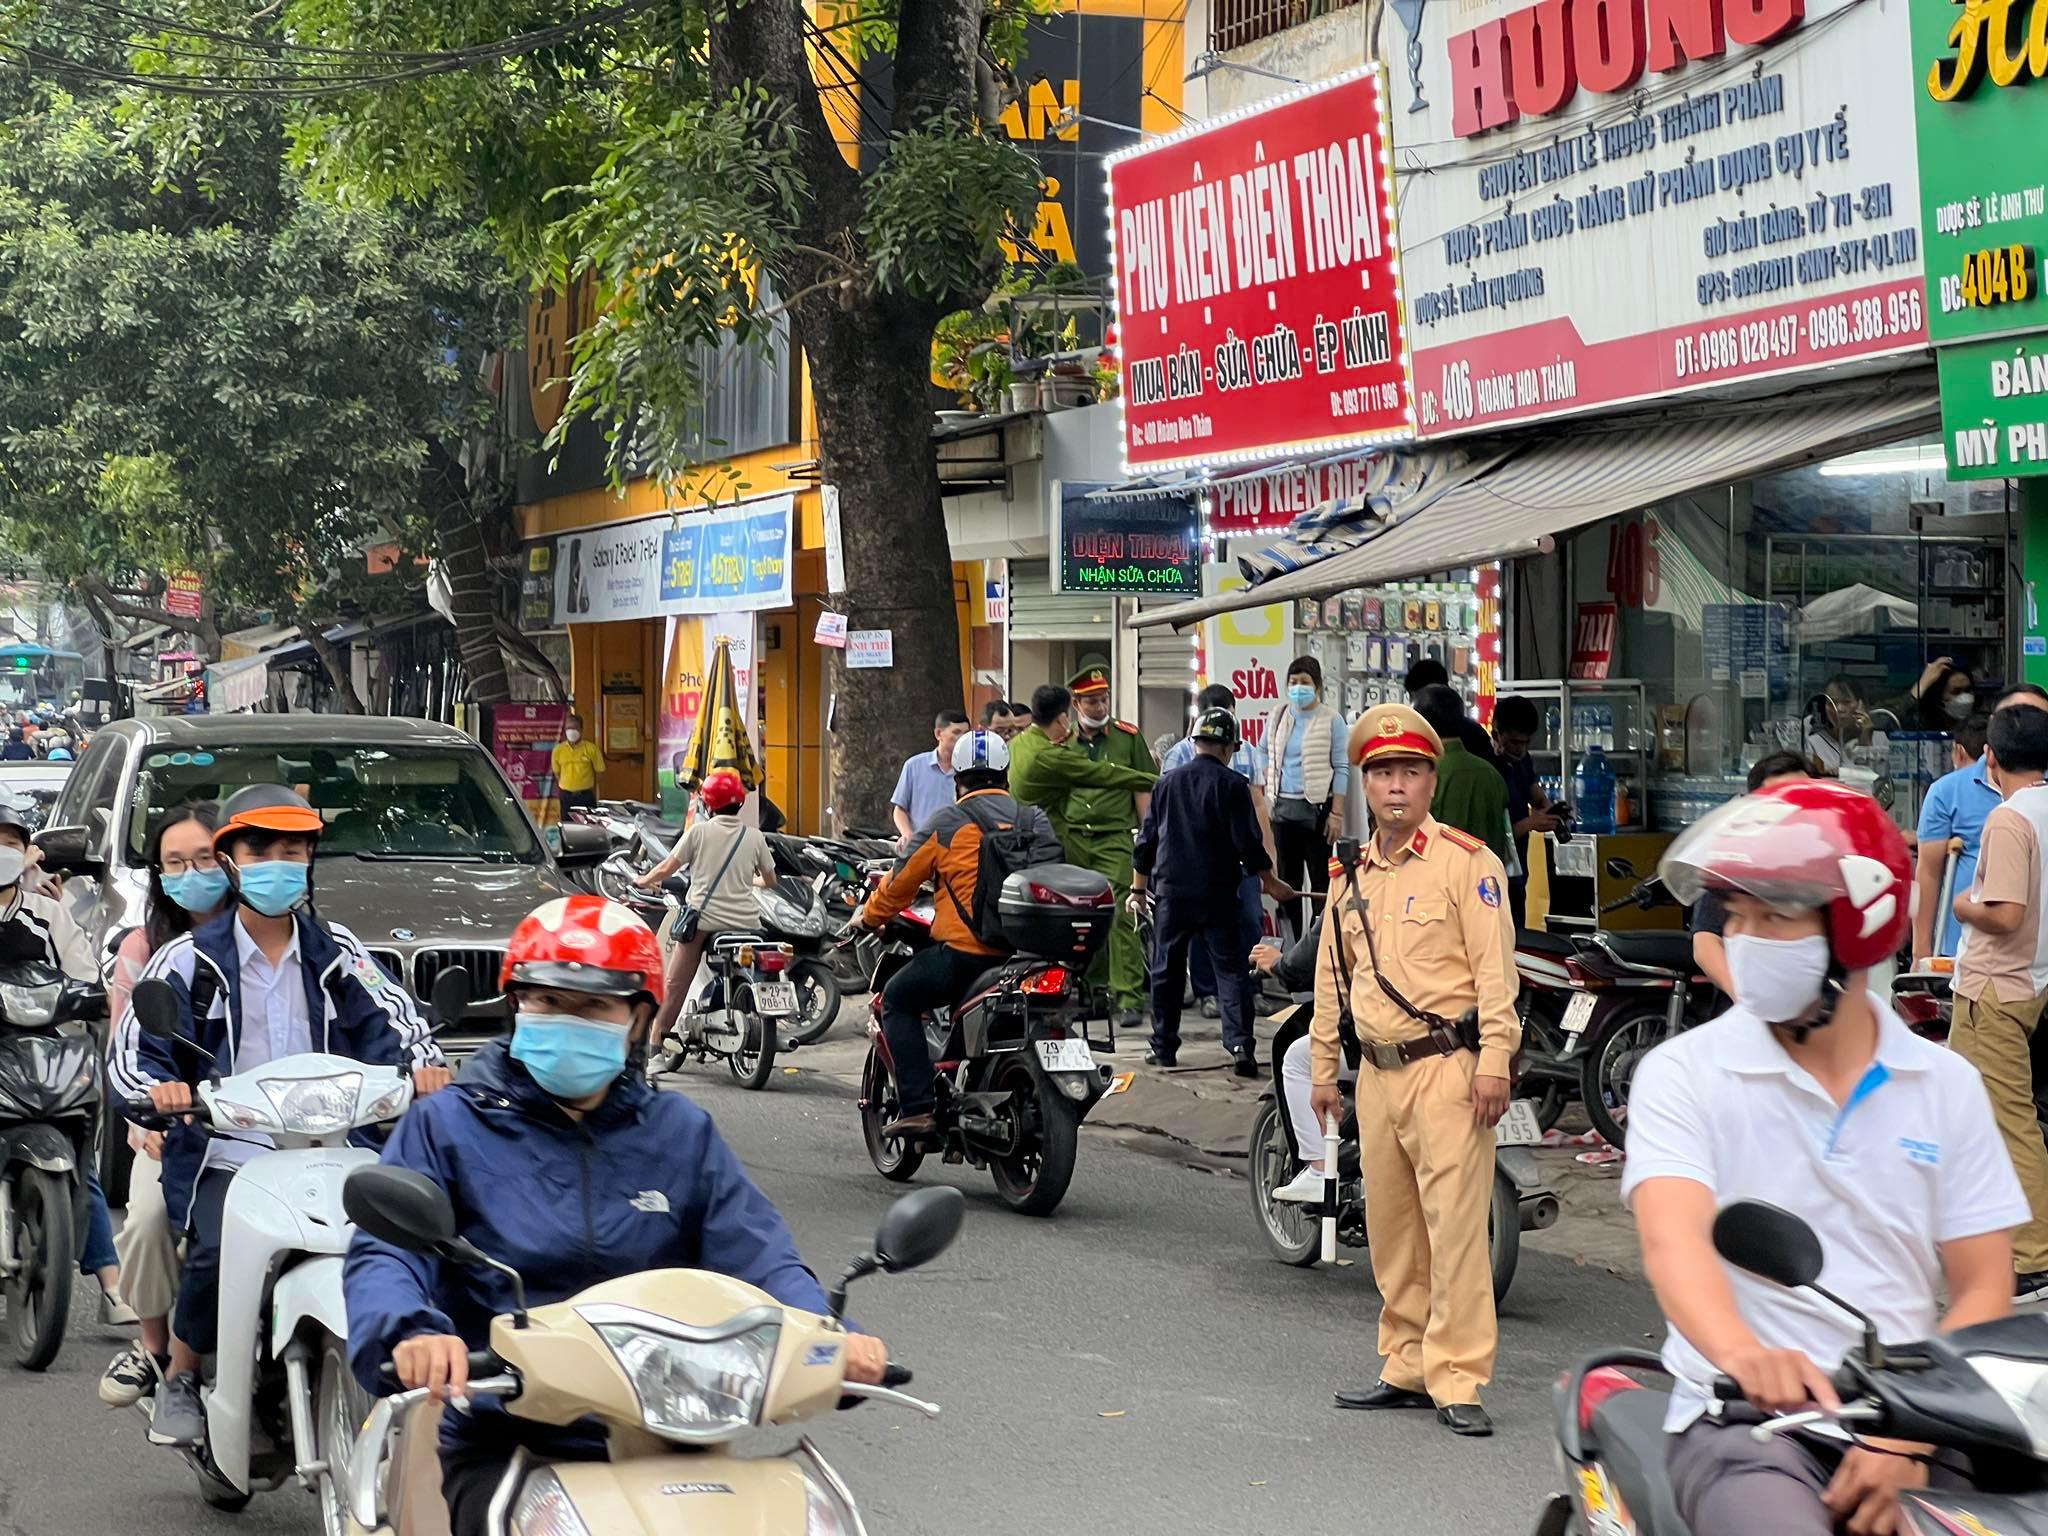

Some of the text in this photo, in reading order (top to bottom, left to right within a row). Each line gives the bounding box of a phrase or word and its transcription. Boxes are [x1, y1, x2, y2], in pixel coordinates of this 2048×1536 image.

[1539, 135, 1575, 183] BÁN
[1723, 60, 1784, 124] PHẨM
[1658, 146, 1715, 207] PHẨM
[1718, 142, 1772, 196] DỤNG
[1775, 132, 1804, 179] CỤ
[1805, 128, 1820, 166] Y
[1821, 104, 1849, 160] TẾ
[1121, 133, 1381, 333] PHỤ KIỆN ĐIỆN THOẠI
[1986, 191, 1998, 224] LÊ
[2001, 192, 2022, 221] ANH
[1809, 288, 1922, 350] 0986.388.956
[1131, 357, 1166, 406] MUA
[1167, 343, 1202, 400] BÁN
[1215, 329, 1252, 392] SỬA
[1252, 323, 1302, 383] CHỮA
[1314, 315, 1338, 374] ÉP
[1341, 307, 1391, 369] KÍNH
[1442, 360, 1473, 420] 406
[1477, 370, 1516, 415] HOÀNG
[1516, 368, 1540, 407] HOA
[1541, 354, 1577, 401] THÁM
[1357, 386, 1369, 413] 77
[1369, 384, 1381, 411] 11
[1955, 418, 2048, 467] MỸ PH
[1080, 566, 1115, 584] NHẬN
[1118, 565, 1144, 583] SỬA
[1606, 520, 1661, 608] 406
[1577, 613, 1614, 651] TAXI
[1231, 657, 1279, 699] SỬA
